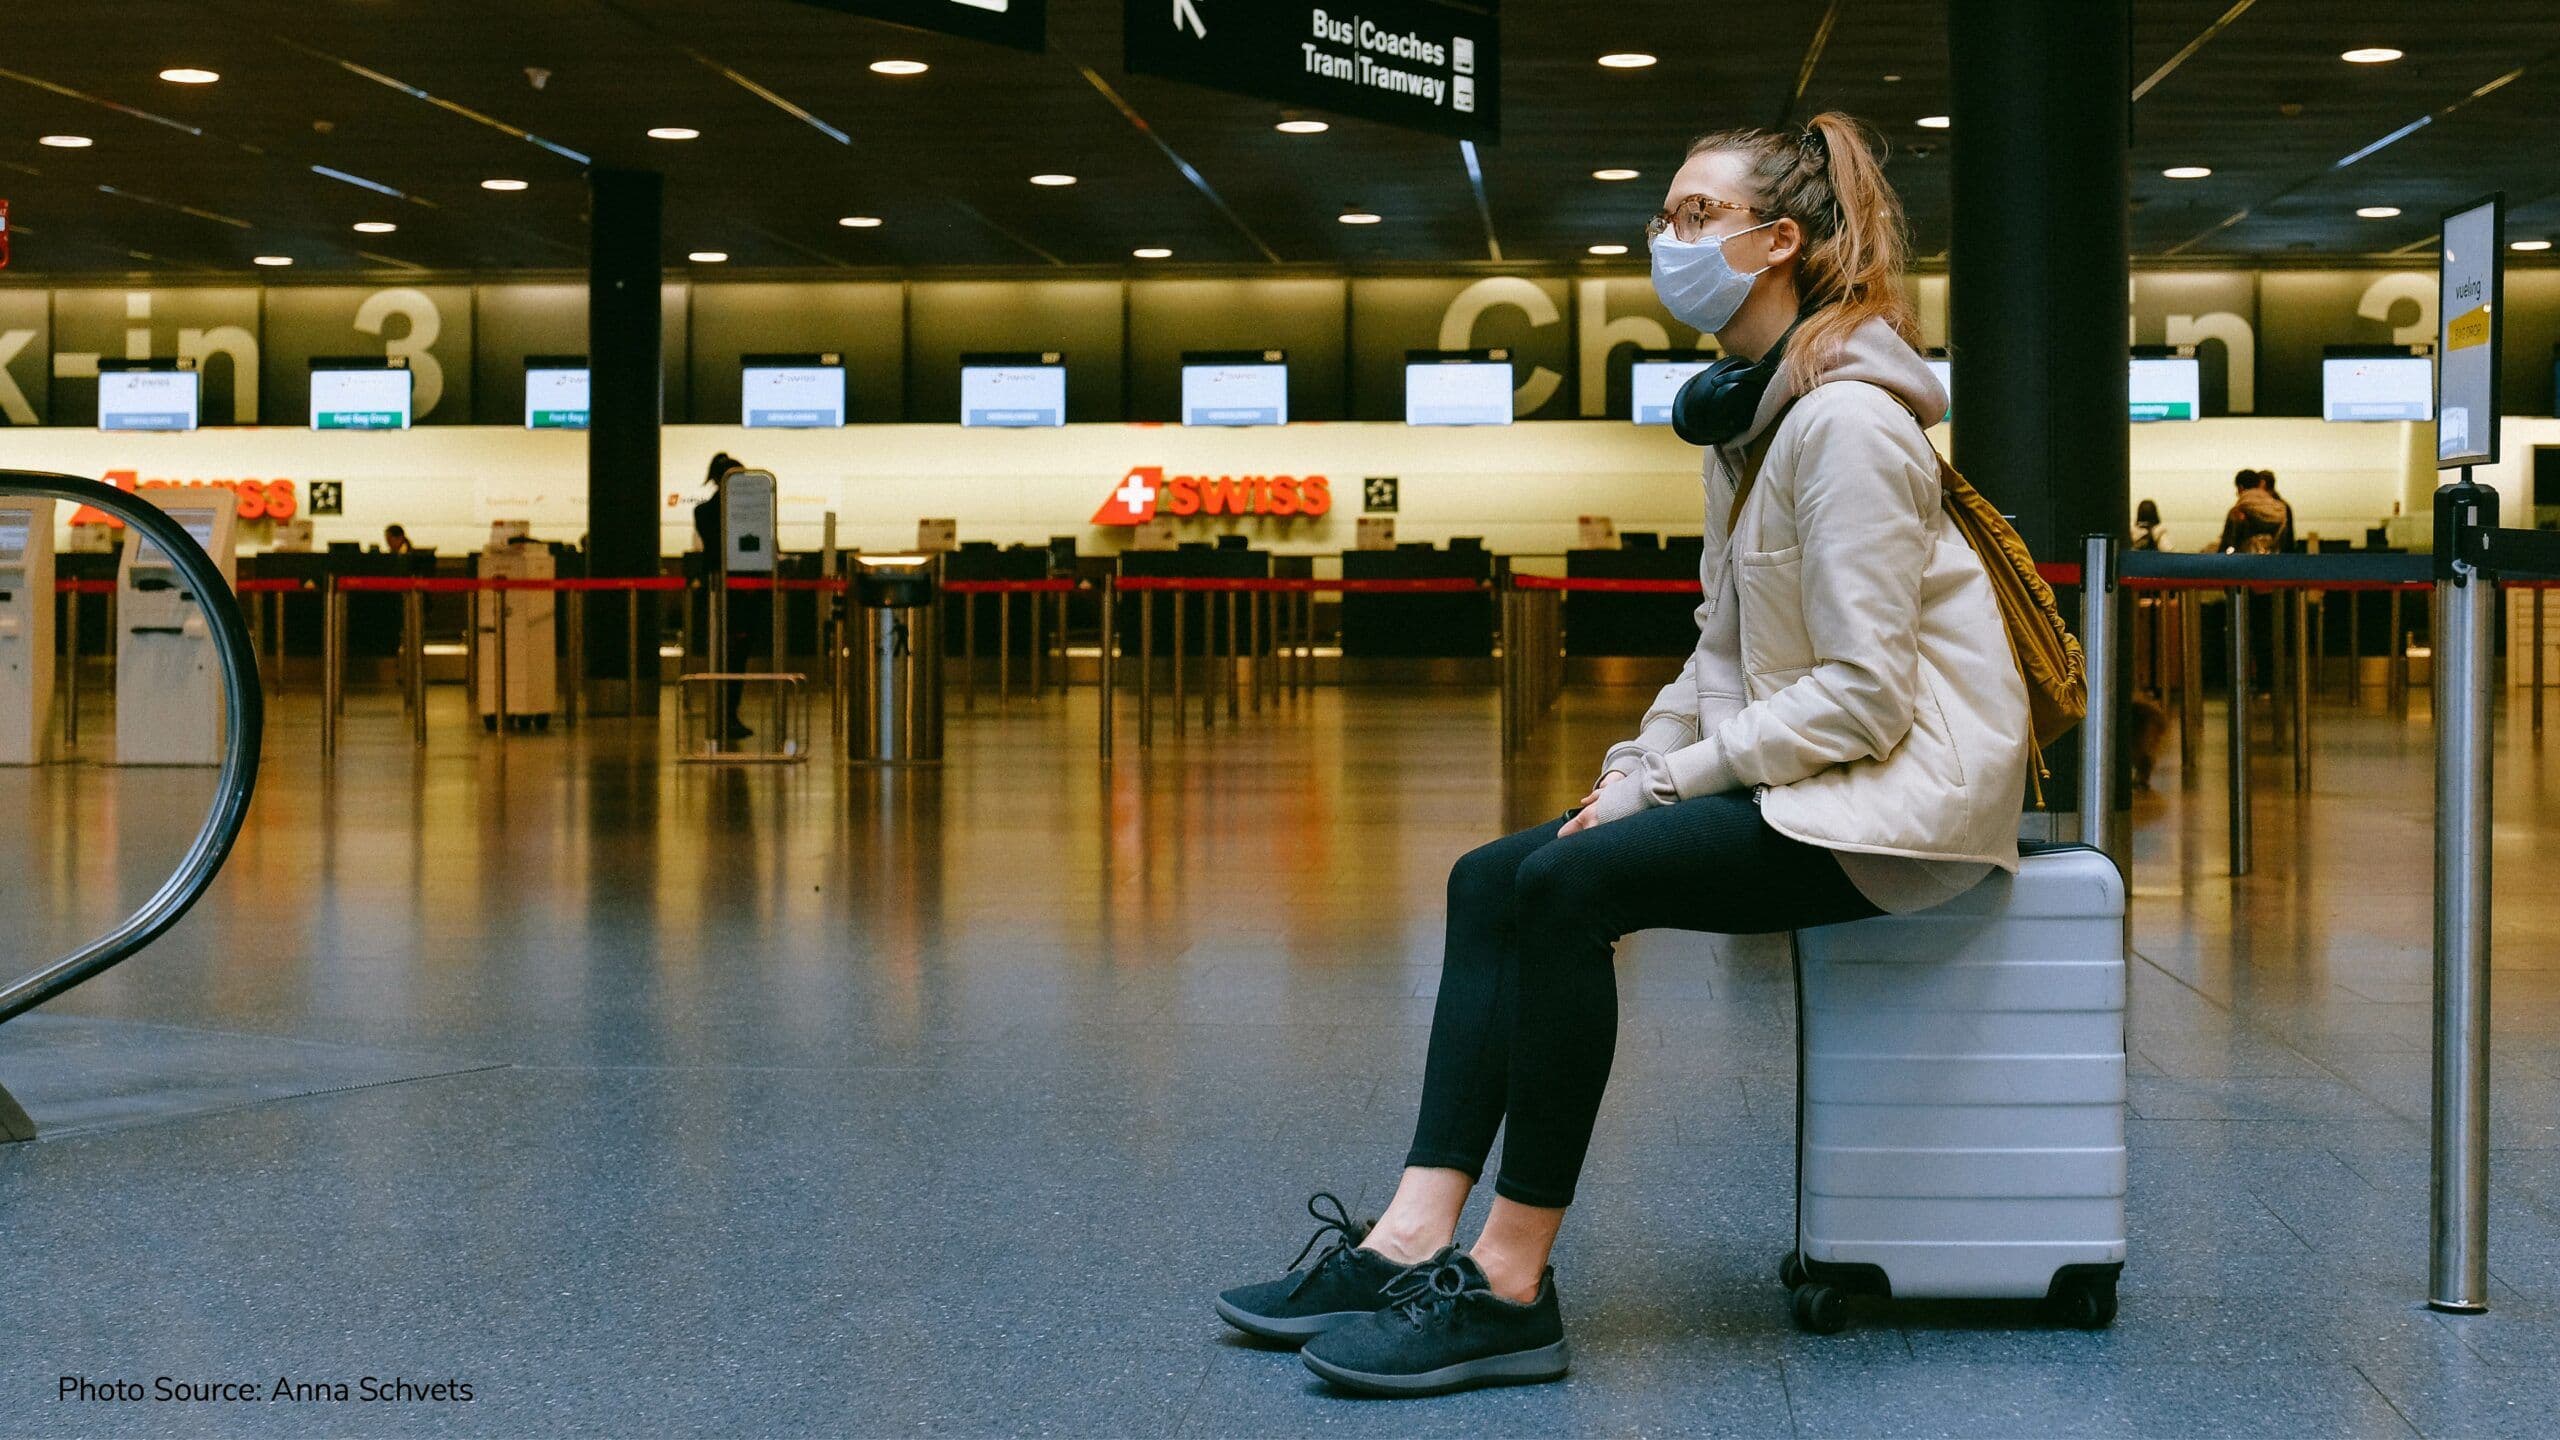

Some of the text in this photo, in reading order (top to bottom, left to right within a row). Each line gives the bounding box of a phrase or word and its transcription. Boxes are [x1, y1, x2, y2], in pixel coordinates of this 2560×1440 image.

[1313, 8, 1446, 67] Bus Coaches
[1302, 42, 1446, 106] Tram Tramway
[2455, 275, 2482, 301] vueling
[353, 287, 444, 422] 3
[1168, 475, 1332, 516] SWISS
